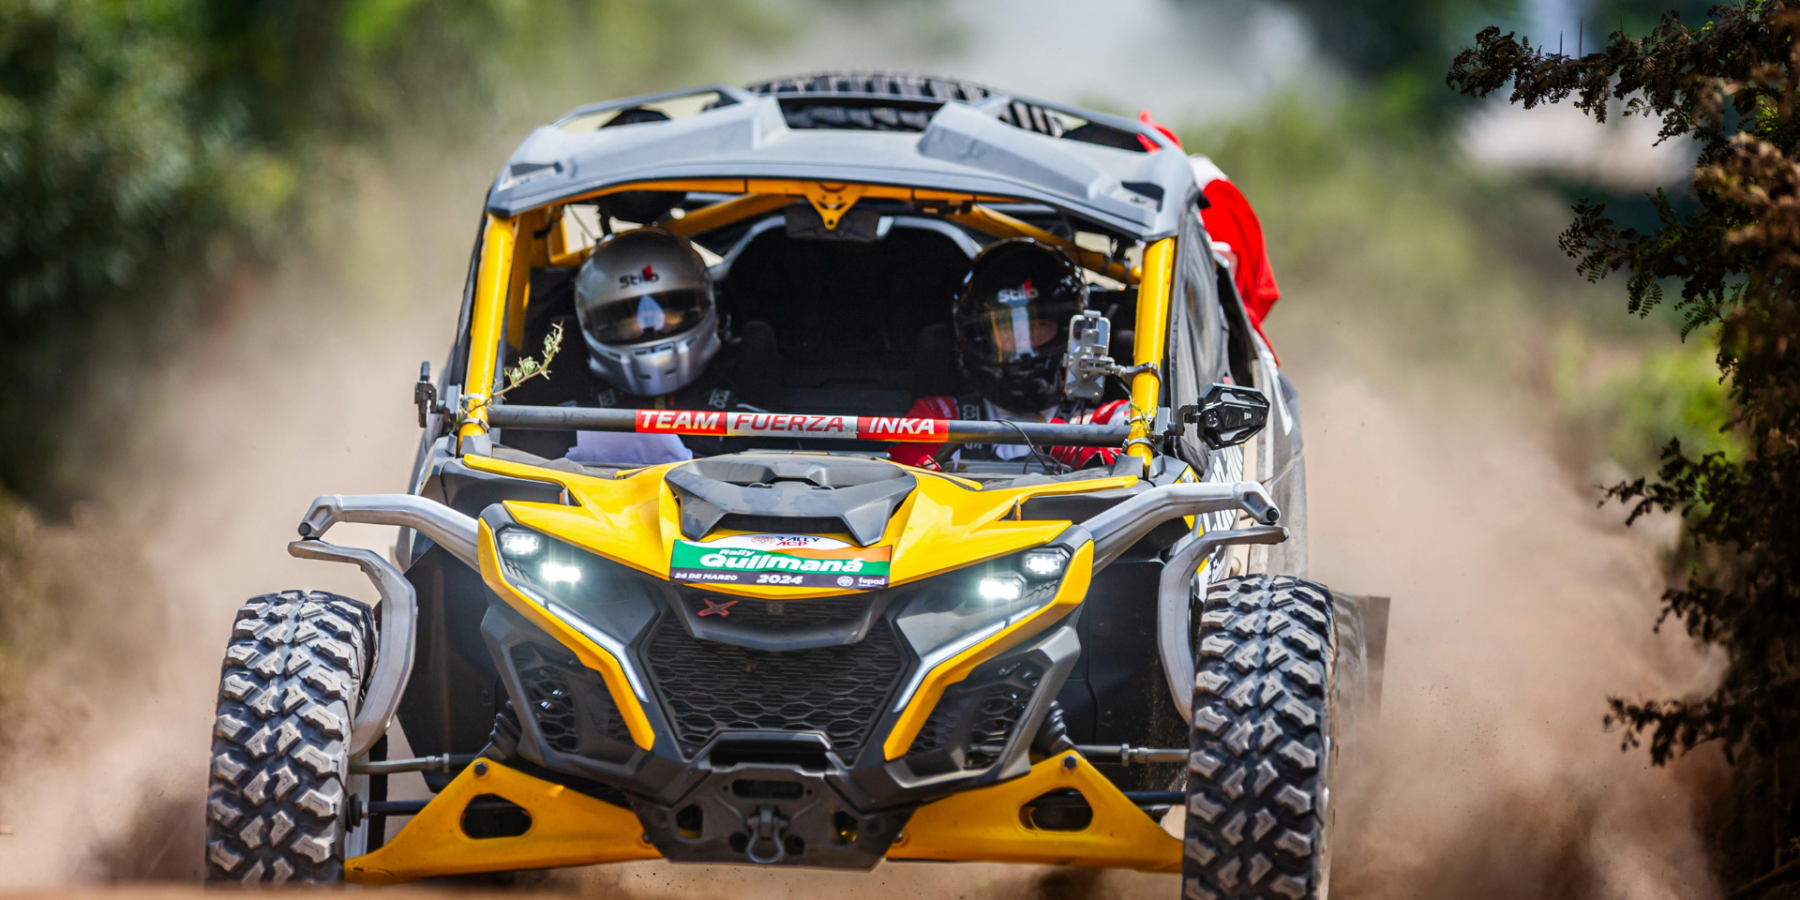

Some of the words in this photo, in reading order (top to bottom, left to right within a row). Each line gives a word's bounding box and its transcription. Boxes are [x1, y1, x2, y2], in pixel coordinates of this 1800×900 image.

[997, 279, 1039, 304] Stilo
[640, 410, 719, 430] TEAM
[733, 413, 843, 432] FUERZA
[868, 416, 935, 435] INKA
[719, 549, 755, 557] Rally
[700, 553, 865, 573] Quilmaná
[702, 573, 738, 581] MARZO
[756, 574, 804, 585] 2024
